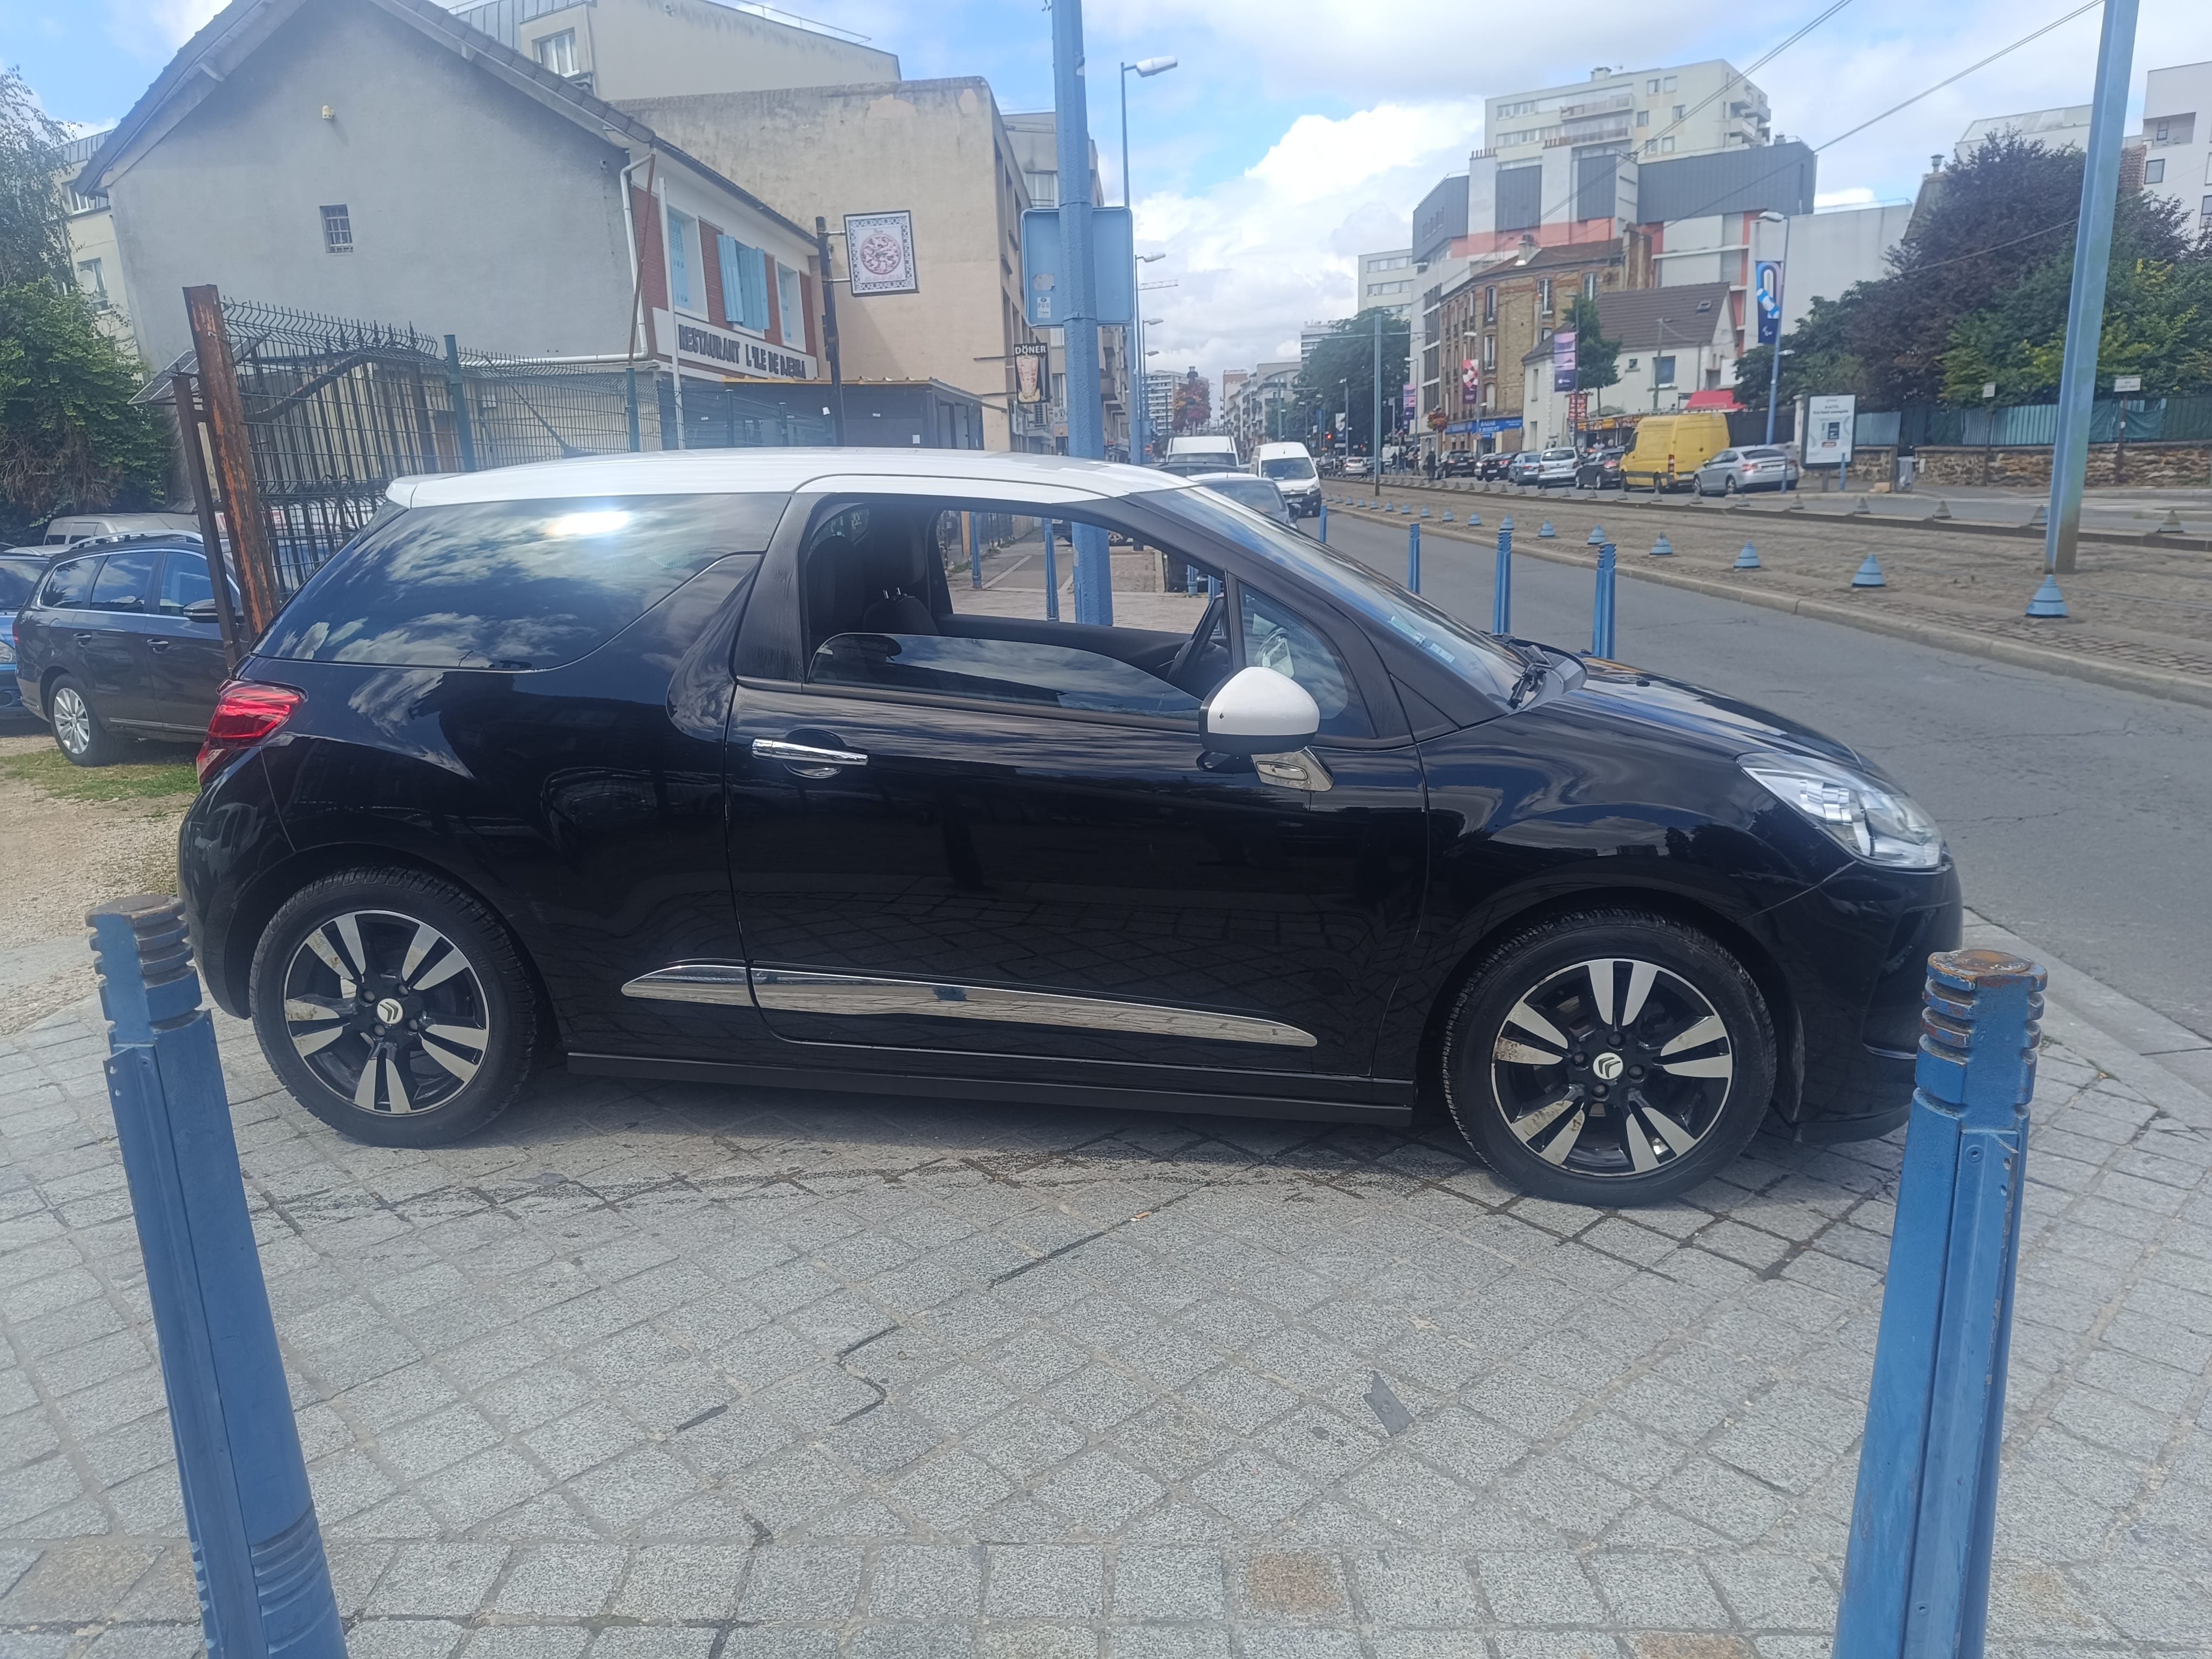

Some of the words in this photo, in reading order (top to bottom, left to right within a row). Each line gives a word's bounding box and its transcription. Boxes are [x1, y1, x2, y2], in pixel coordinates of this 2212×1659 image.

[678, 324, 740, 364] RESTAURANT
[768, 351, 779, 374] DE
[1015, 345, 1046, 355] DÖNER
